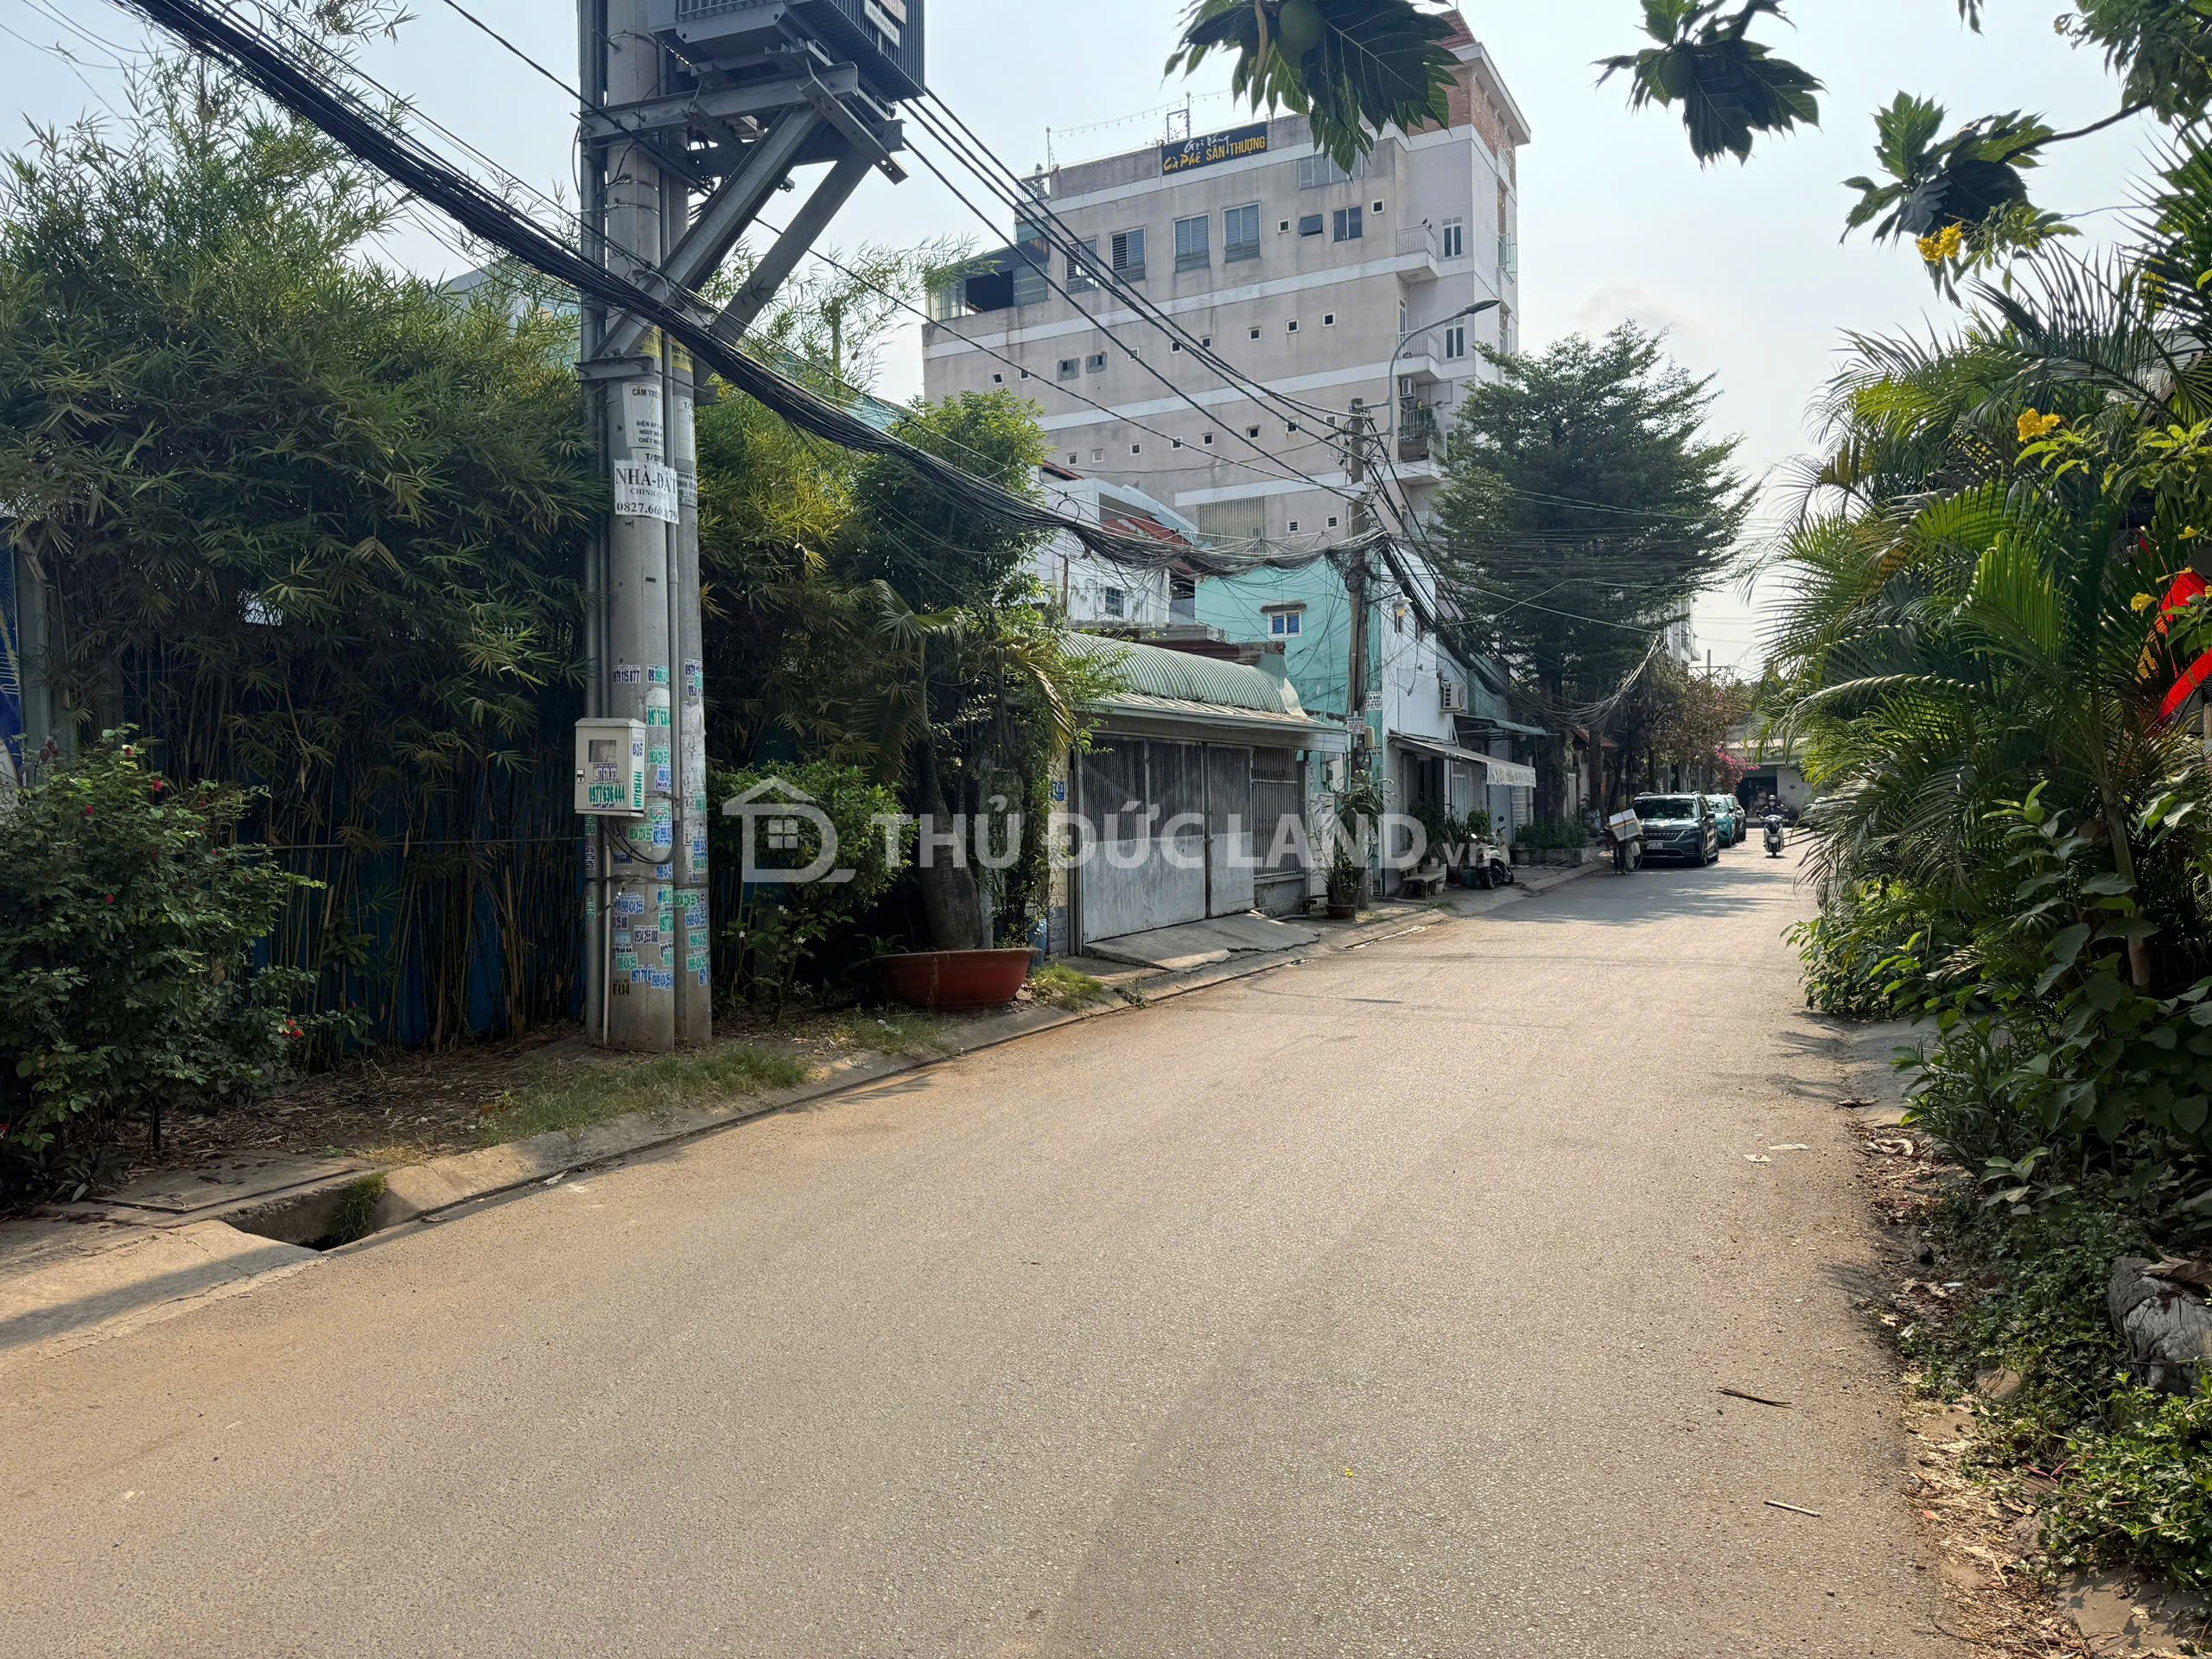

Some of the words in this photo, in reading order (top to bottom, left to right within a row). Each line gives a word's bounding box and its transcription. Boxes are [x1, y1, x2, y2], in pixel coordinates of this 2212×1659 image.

[1180, 151, 1201, 168] Phê
[1206, 144, 1225, 161] SÂN
[1230, 136, 1266, 155] THƯỢNG
